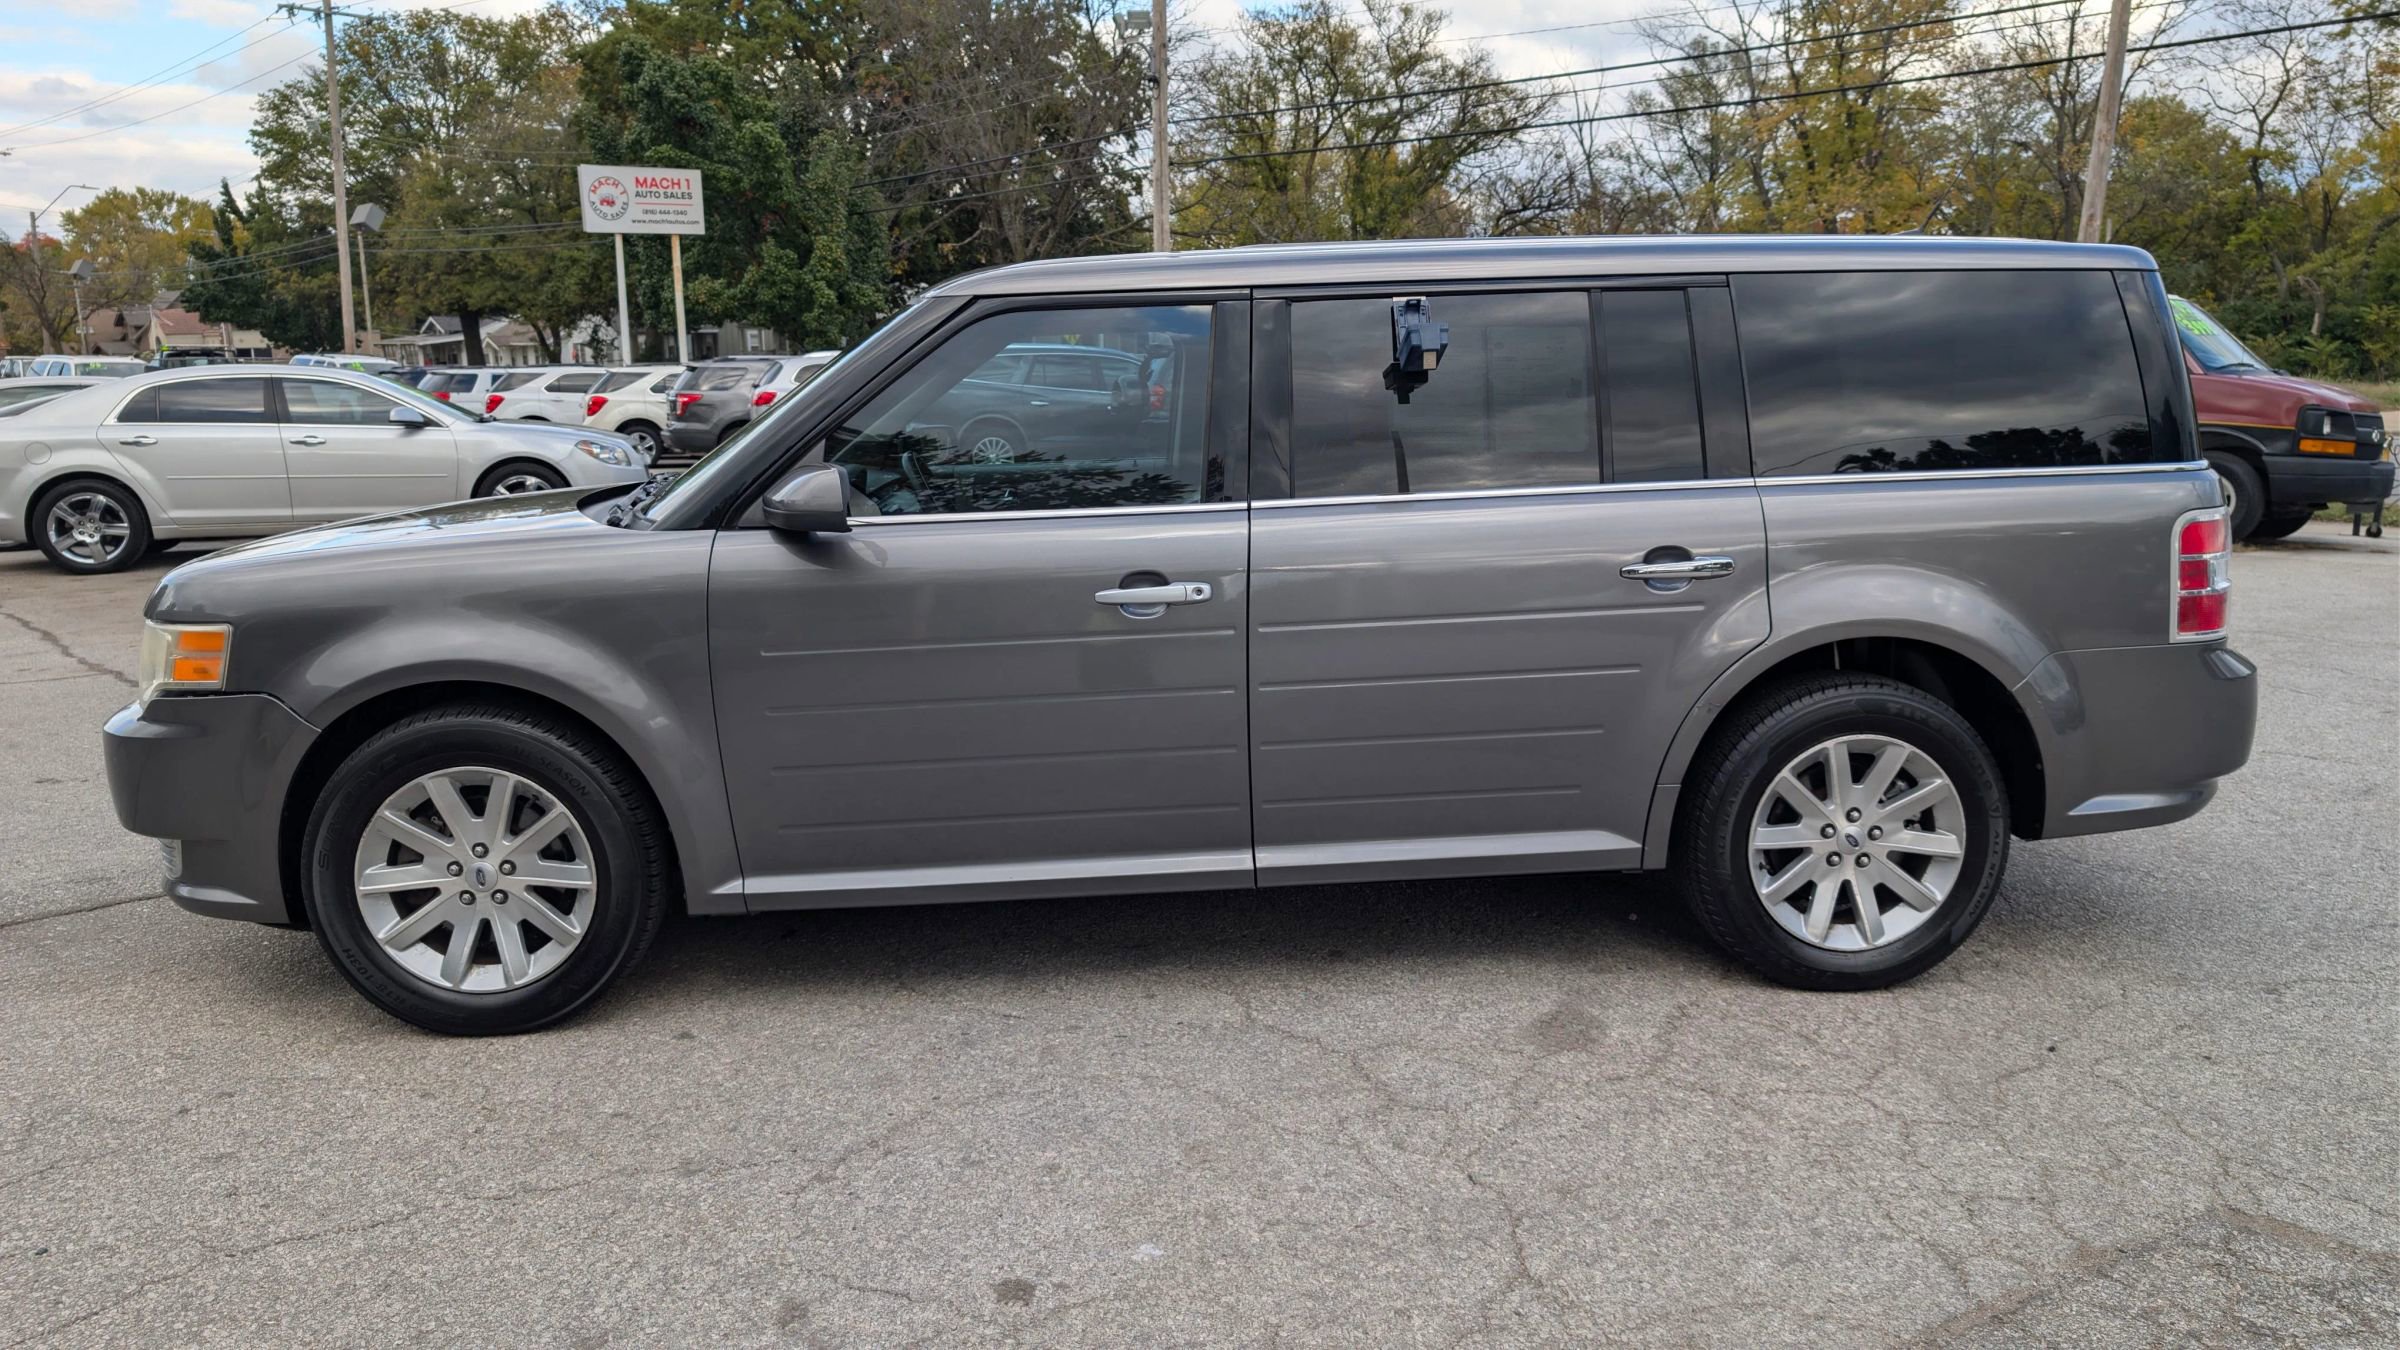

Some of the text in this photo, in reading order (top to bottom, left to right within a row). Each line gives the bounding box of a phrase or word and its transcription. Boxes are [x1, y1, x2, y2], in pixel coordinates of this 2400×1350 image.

[591, 178, 620, 195] MACH
[635, 176, 691, 190] MACH 1
[663, 191, 693, 200] SALES
[591, 201, 628, 218] AUTO SALES
[342, 948, 374, 980] 103H
